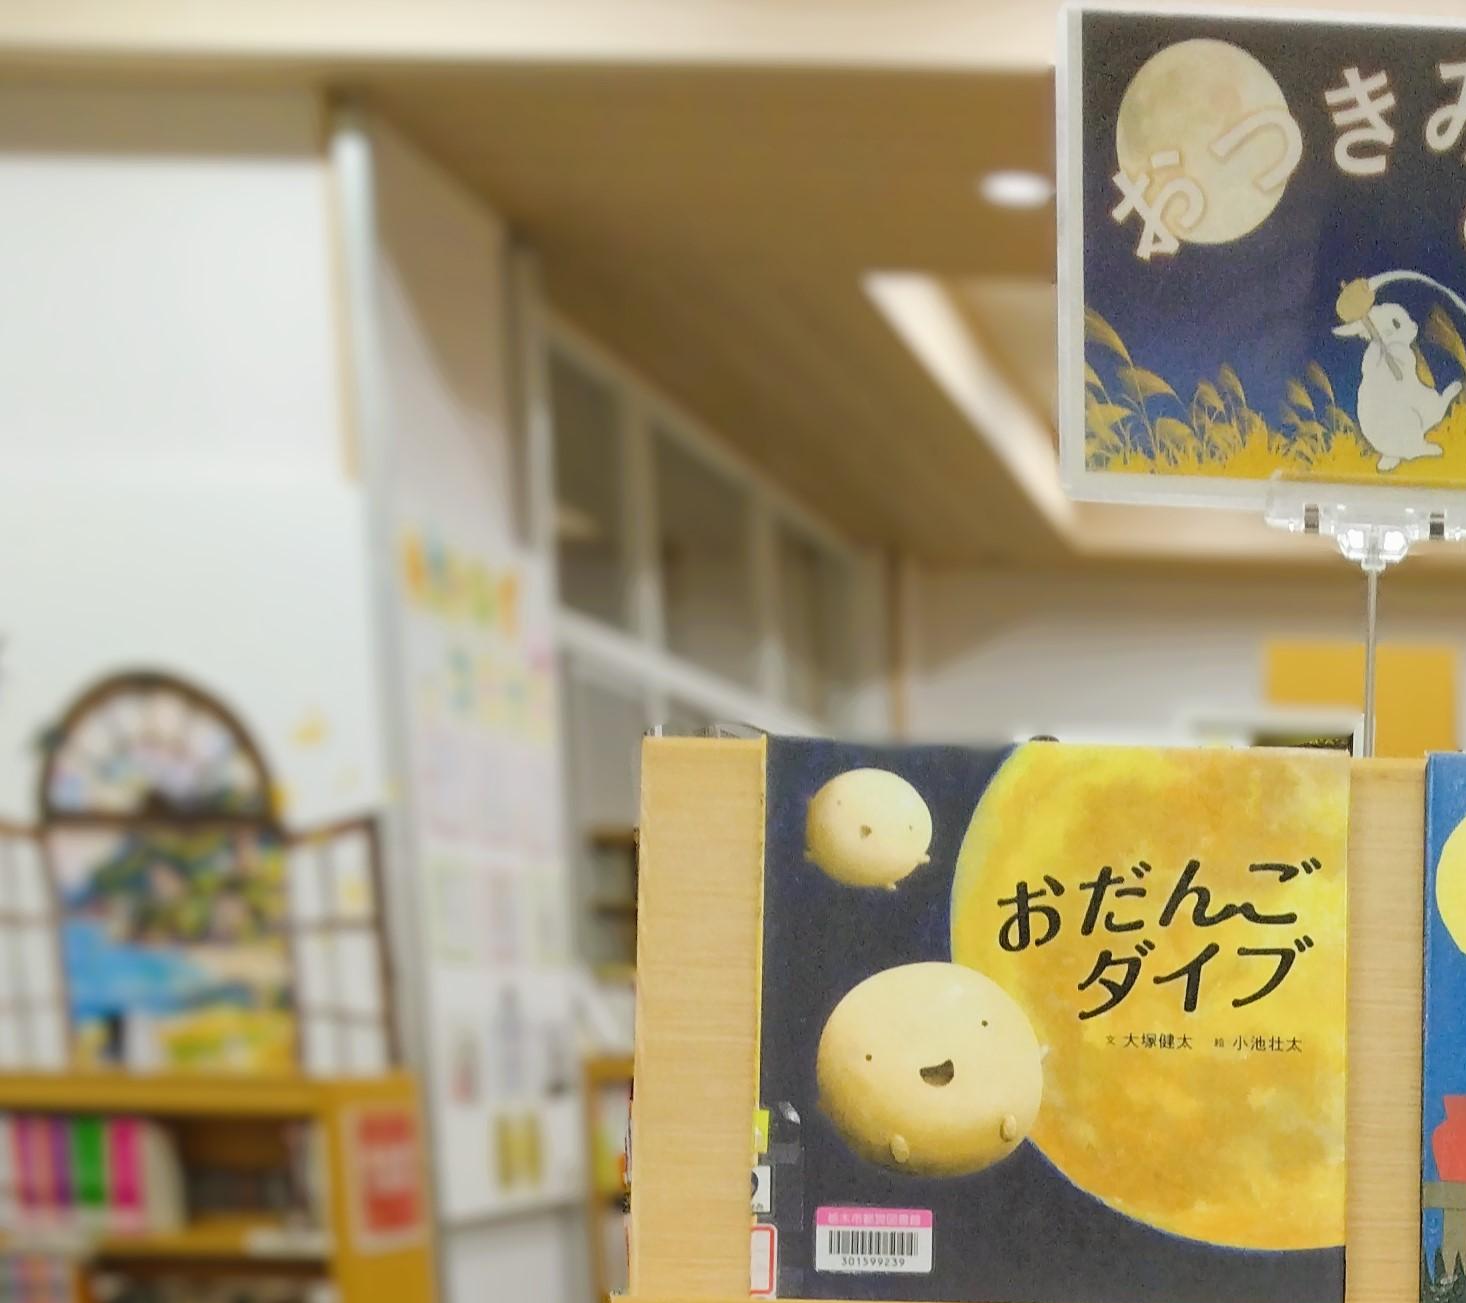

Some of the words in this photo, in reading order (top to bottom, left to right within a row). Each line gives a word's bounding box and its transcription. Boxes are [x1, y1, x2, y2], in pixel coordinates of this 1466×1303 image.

[998, 857, 1323, 952] おだんご
[1077, 935, 1314, 1021] ダイブ
[1123, 1032, 1193, 1049] 大塚健太
[1232, 1035, 1303, 1053] 小池壮太
